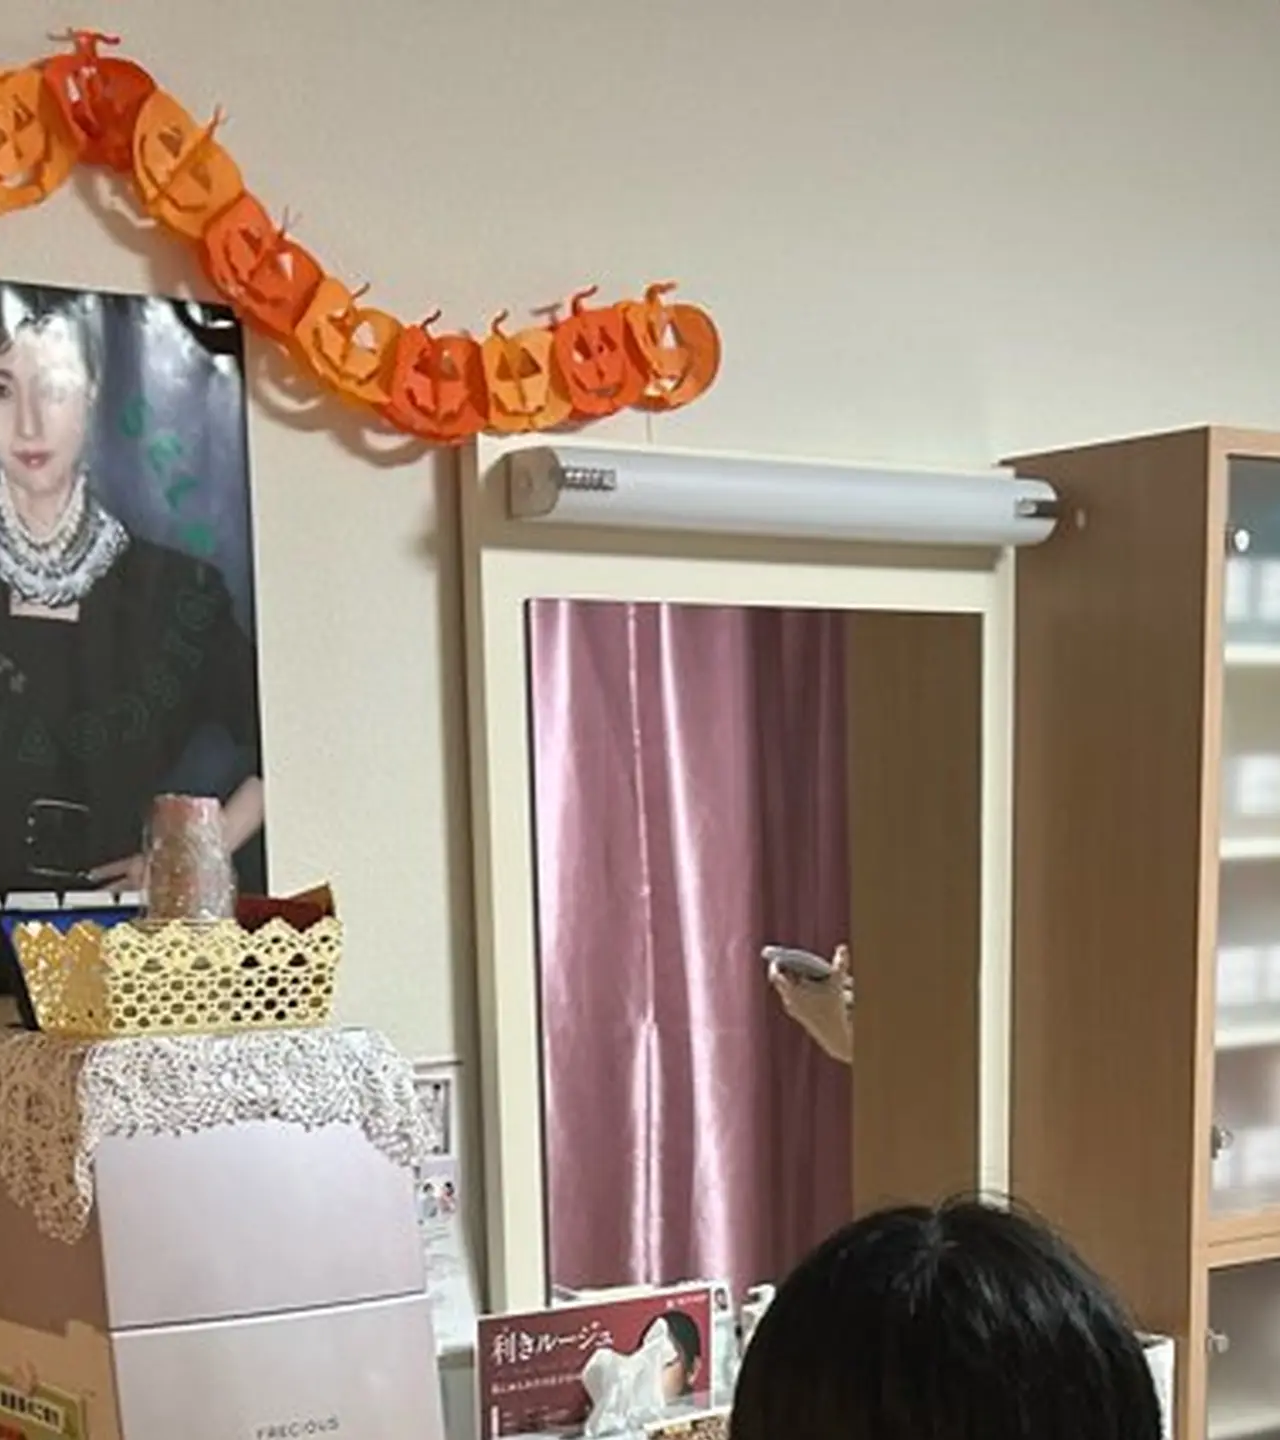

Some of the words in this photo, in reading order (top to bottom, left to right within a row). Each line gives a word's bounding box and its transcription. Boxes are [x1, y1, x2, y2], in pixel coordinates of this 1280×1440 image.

[491, 1320, 614, 1365] 利きルージュ
